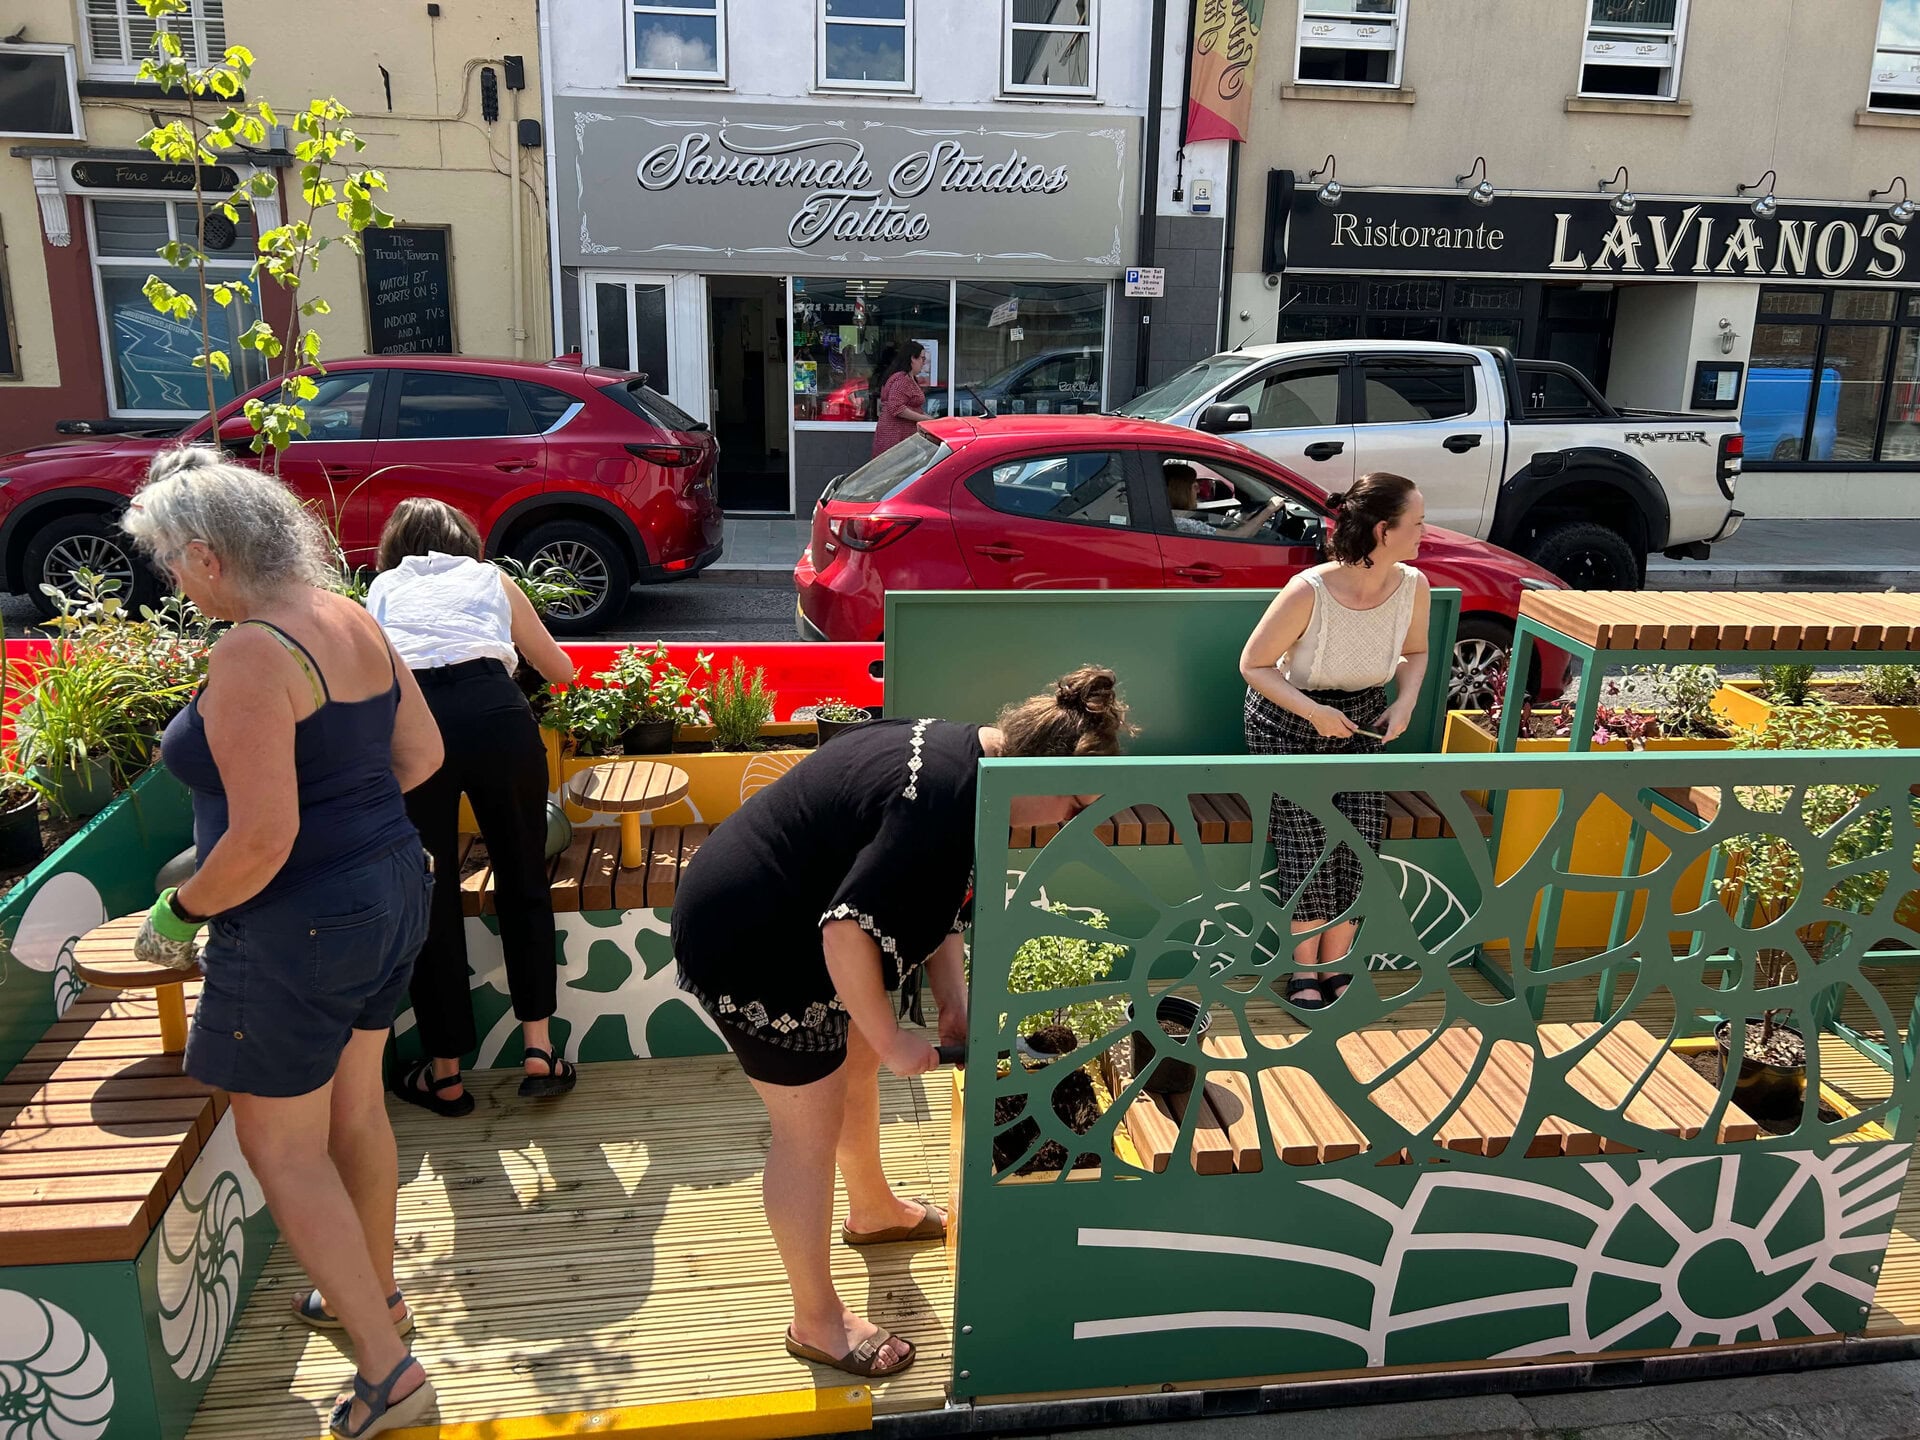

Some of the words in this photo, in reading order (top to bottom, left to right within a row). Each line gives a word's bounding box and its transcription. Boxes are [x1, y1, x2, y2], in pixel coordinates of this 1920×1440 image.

[636, 129, 873, 191] Savannah
[888, 140, 1068, 199] Studios
[115, 167, 149, 182] Fine
[161, 169, 195, 184] Ales
[788, 188, 930, 248] Tattoo
[389, 235, 415, 247] The
[1331, 213, 1505, 250] Ristorante
[1549, 203, 1908, 278] LAVIANO'S
[373, 248, 404, 260] Trout
[404, 249, 439, 261] Tavern
[380, 274, 409, 291] WATCH
[413, 270, 428, 284] BT
[376, 289, 410, 306] SPORTS
[413, 285, 427, 298] ON
[384, 312, 417, 329] INDOOR
[398, 328, 413, 338] AND
[415, 326, 421, 335] A
[420, 339, 433, 350] TV
[1623, 430, 1712, 447] RAPTOR
